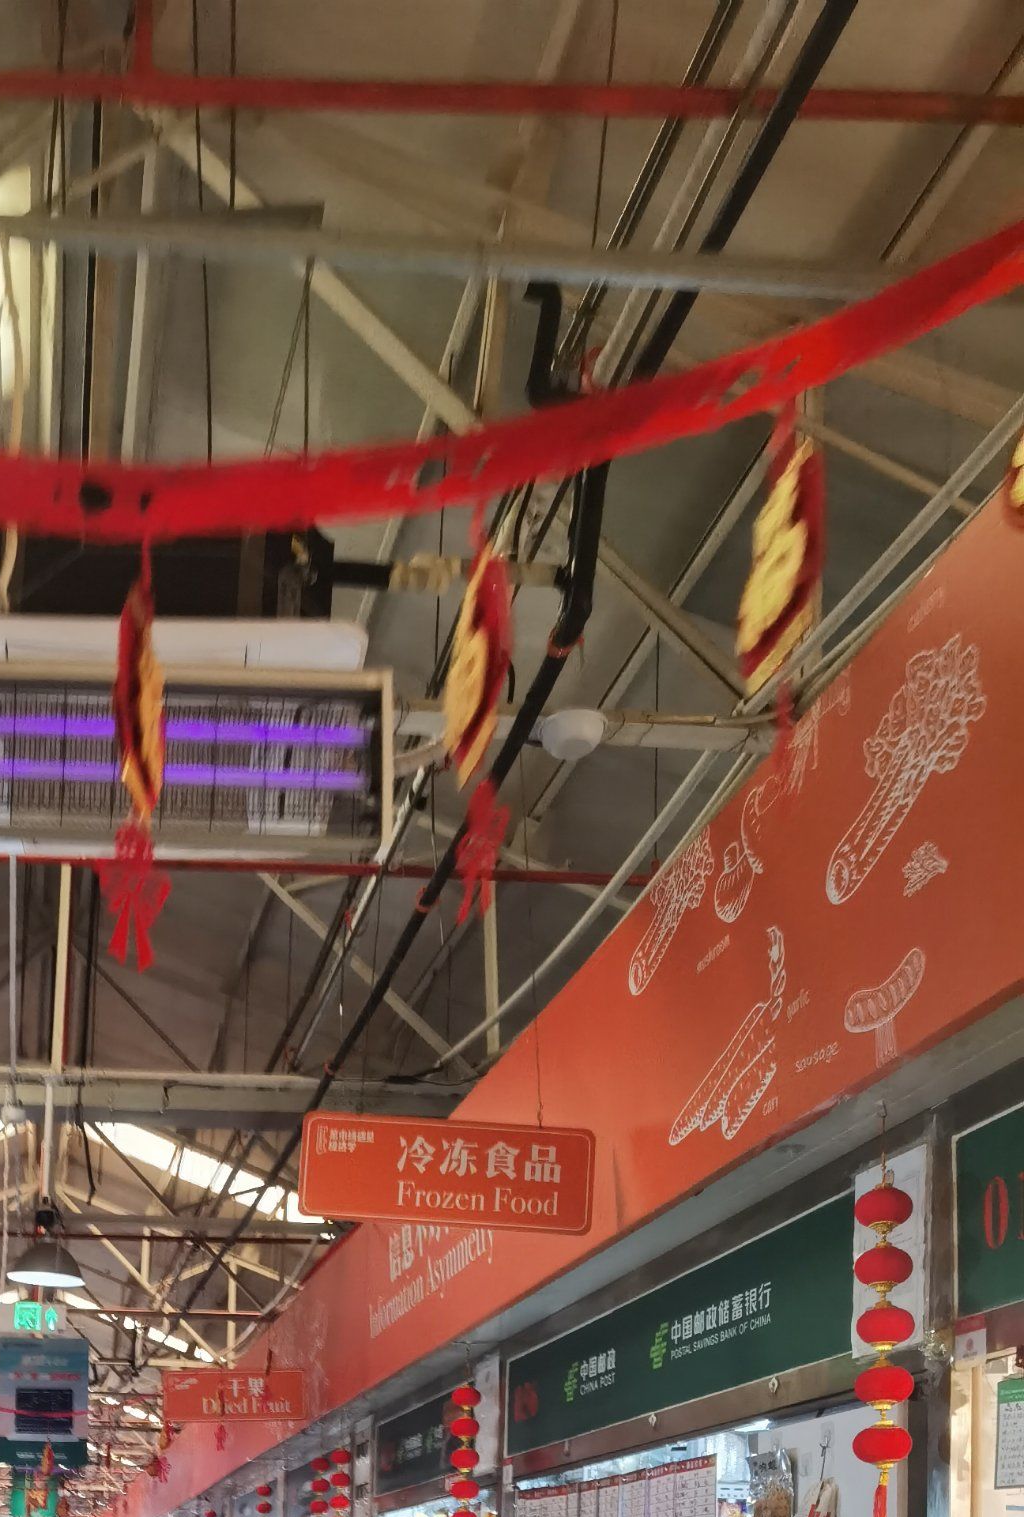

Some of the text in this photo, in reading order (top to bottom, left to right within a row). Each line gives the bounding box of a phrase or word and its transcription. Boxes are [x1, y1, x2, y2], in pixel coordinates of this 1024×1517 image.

[795, 1042, 840, 1073] sausage
[397, 1136, 562, 1184] 冷冻食品
[395, 1180, 559, 1216] Frozen Food
[670, 1281, 772, 1345] 中国邮政储蓄银行
[670, 1313, 772, 1361] POSTAL SAVINGS BANK OF CHINA
[580, 1347, 616, 1382] 中国邮政
[202, 1396, 248, 1414] Died
[227, 1377, 265, 1398] 干果
